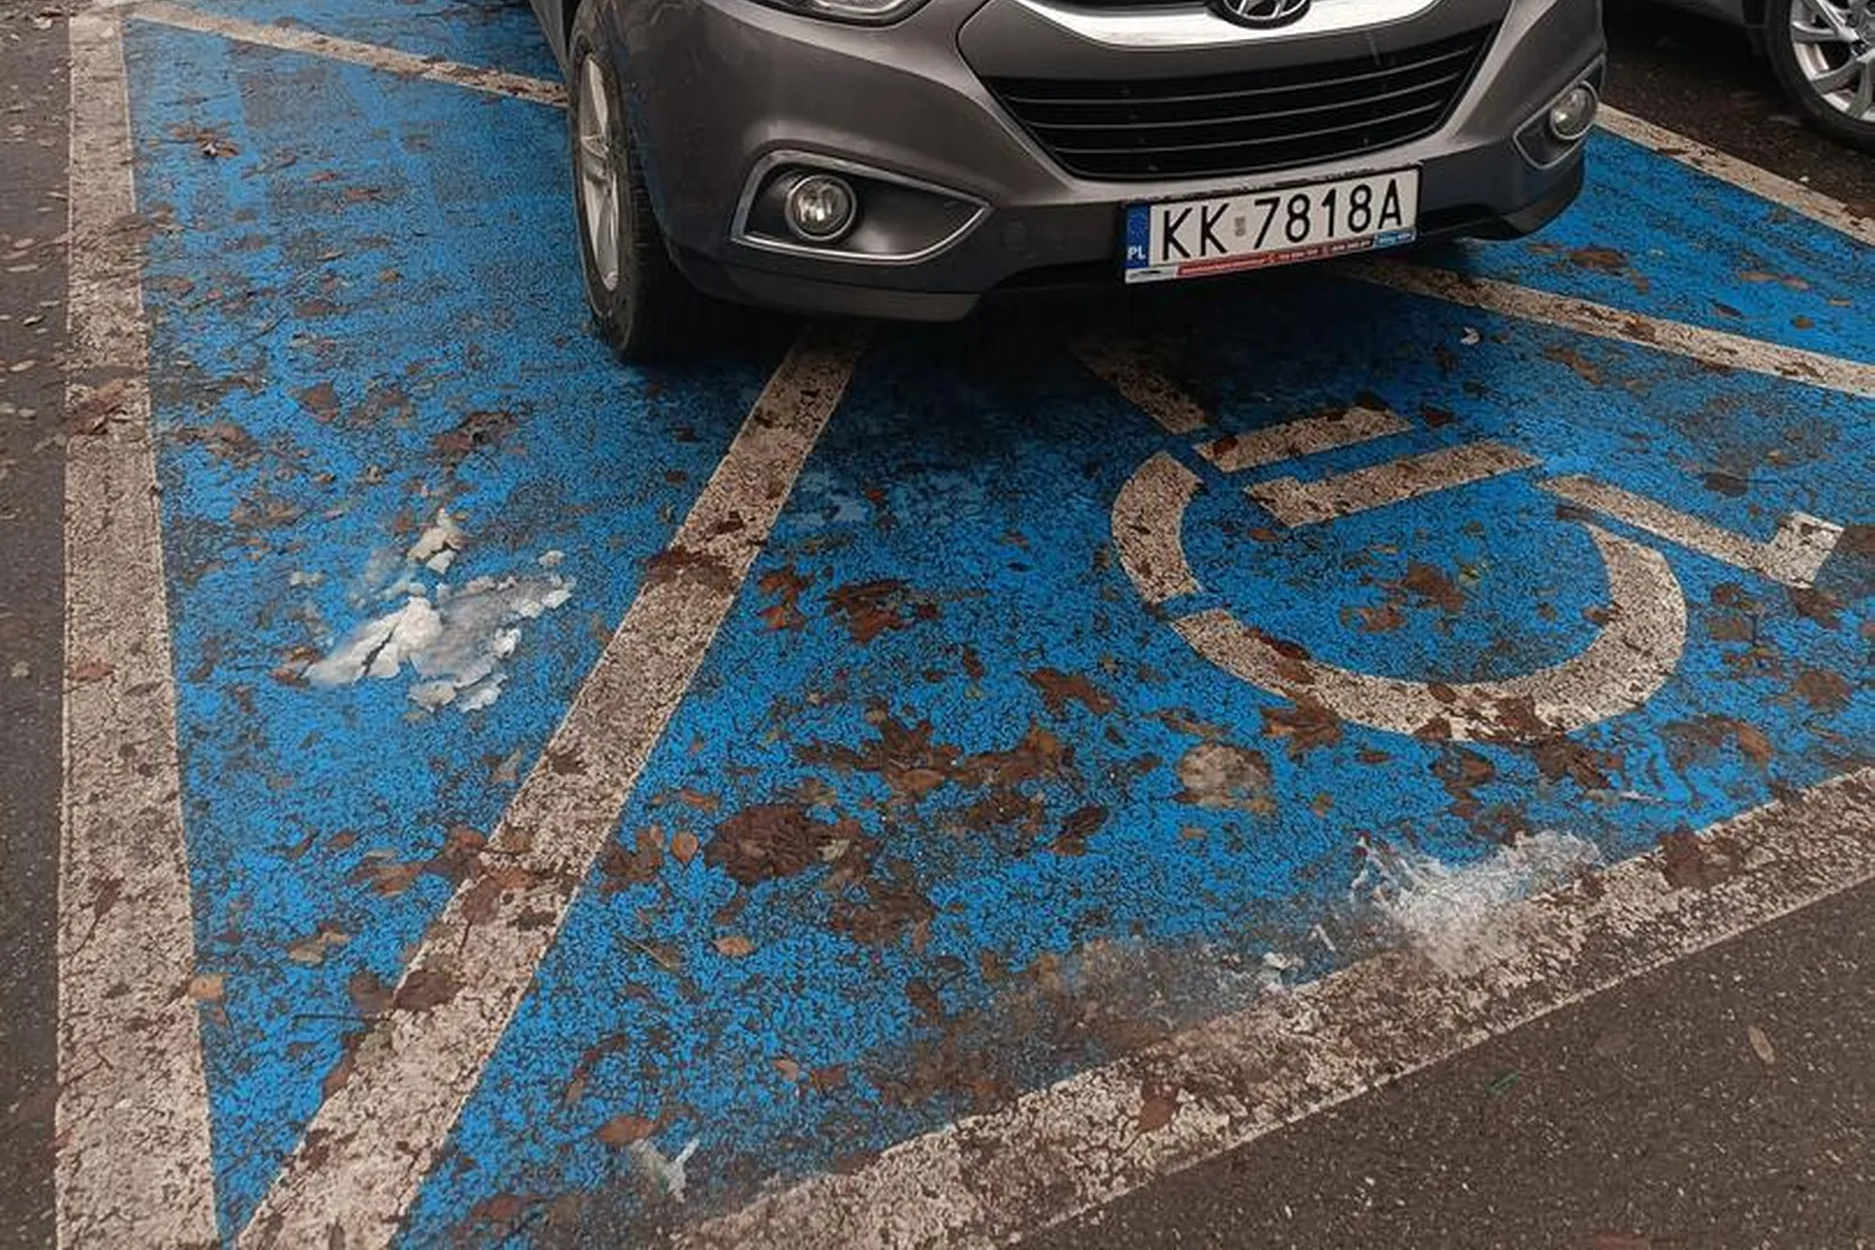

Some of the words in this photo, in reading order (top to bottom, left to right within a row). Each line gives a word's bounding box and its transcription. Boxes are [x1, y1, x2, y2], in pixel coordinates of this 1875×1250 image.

[1162, 203, 1229, 261] KK
[1253, 179, 1403, 250] 7818A
[1127, 246, 1146, 260] PL
